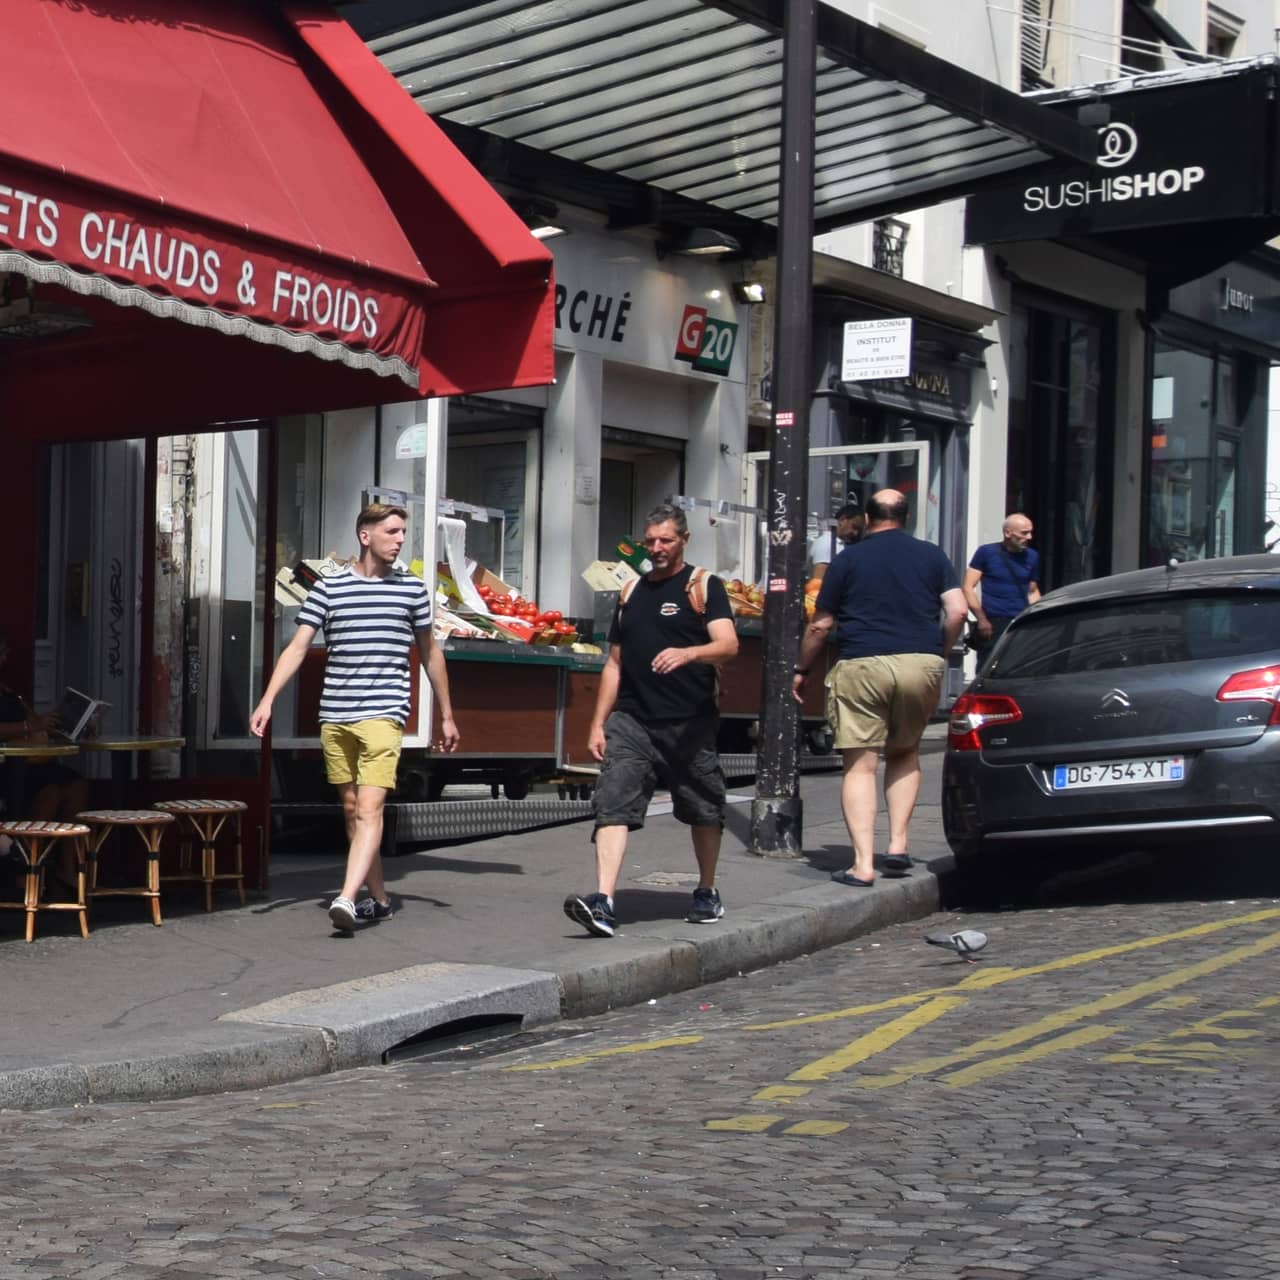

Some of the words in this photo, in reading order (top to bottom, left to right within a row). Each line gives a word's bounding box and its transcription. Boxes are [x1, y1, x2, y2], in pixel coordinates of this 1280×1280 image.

[80, 212, 221, 295] CHAUDS
[237, 260, 256, 306] &
[272, 270, 379, 338] FROIDS
[877, 320, 906, 328] DONNA
[681, 314, 733, 361] G20
[857, 336, 896, 345] INSTITUT
[1069, 760, 1168, 784] DG-754-XT
